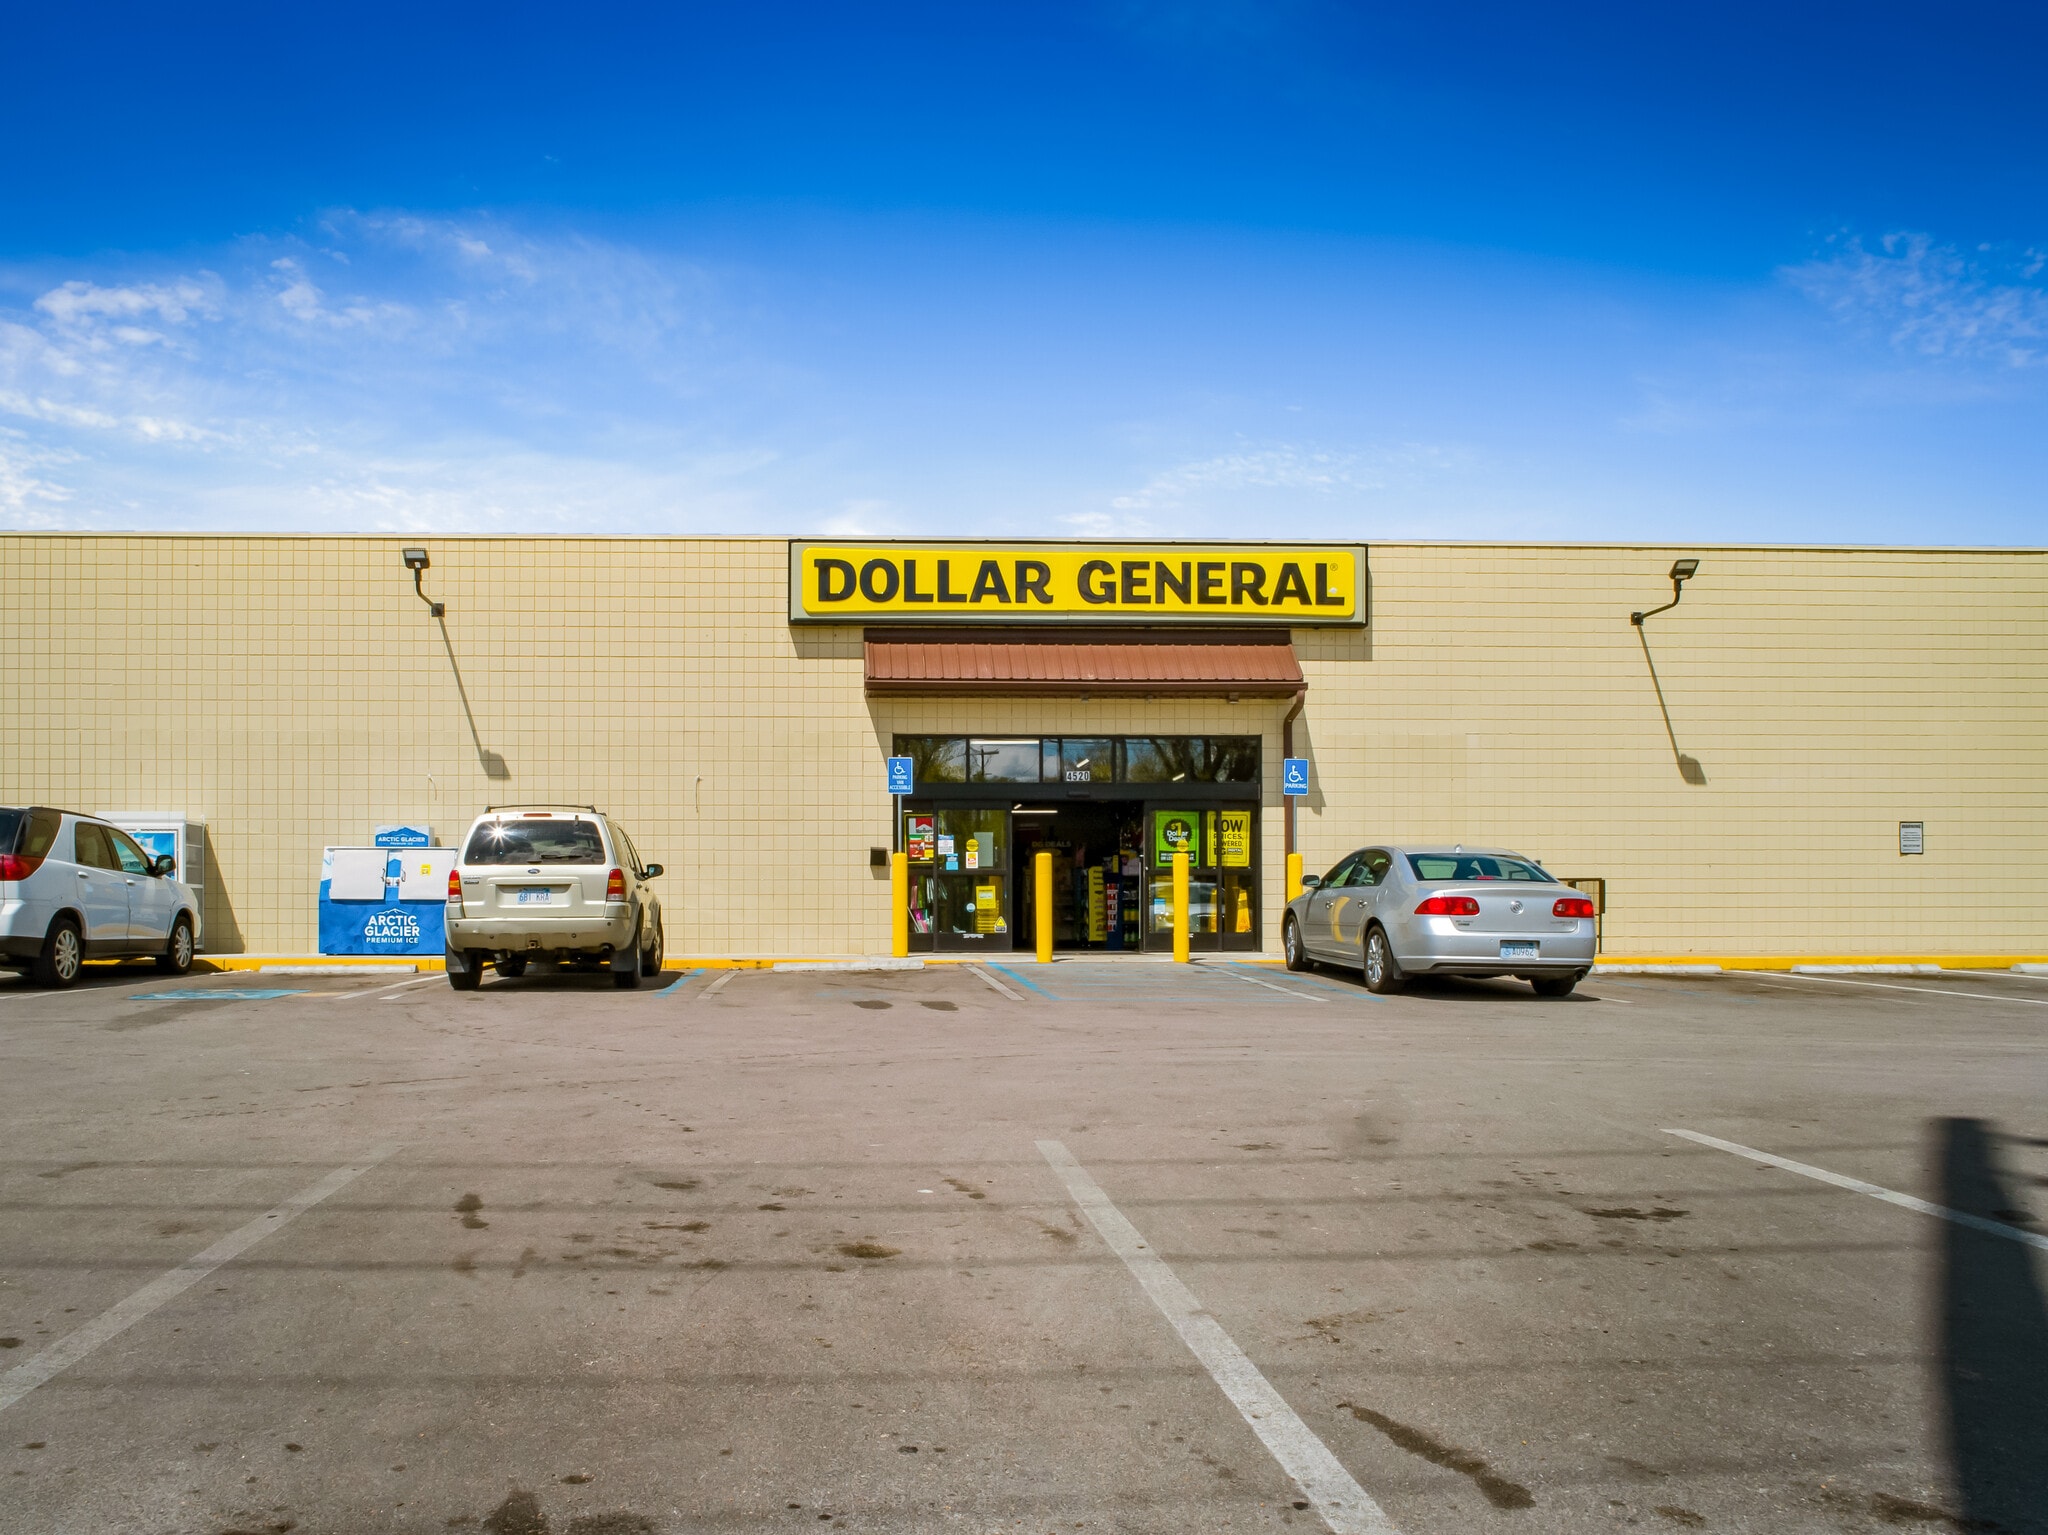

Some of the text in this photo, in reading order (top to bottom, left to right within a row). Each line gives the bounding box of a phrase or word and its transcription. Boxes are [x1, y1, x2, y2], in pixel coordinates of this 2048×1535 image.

[814, 558, 1345, 606] DOLLAR GENERAL
[1067, 772, 1089, 781] 4520
[368, 915, 417, 926] ARCTIC
[364, 926, 420, 937] GLACIER
